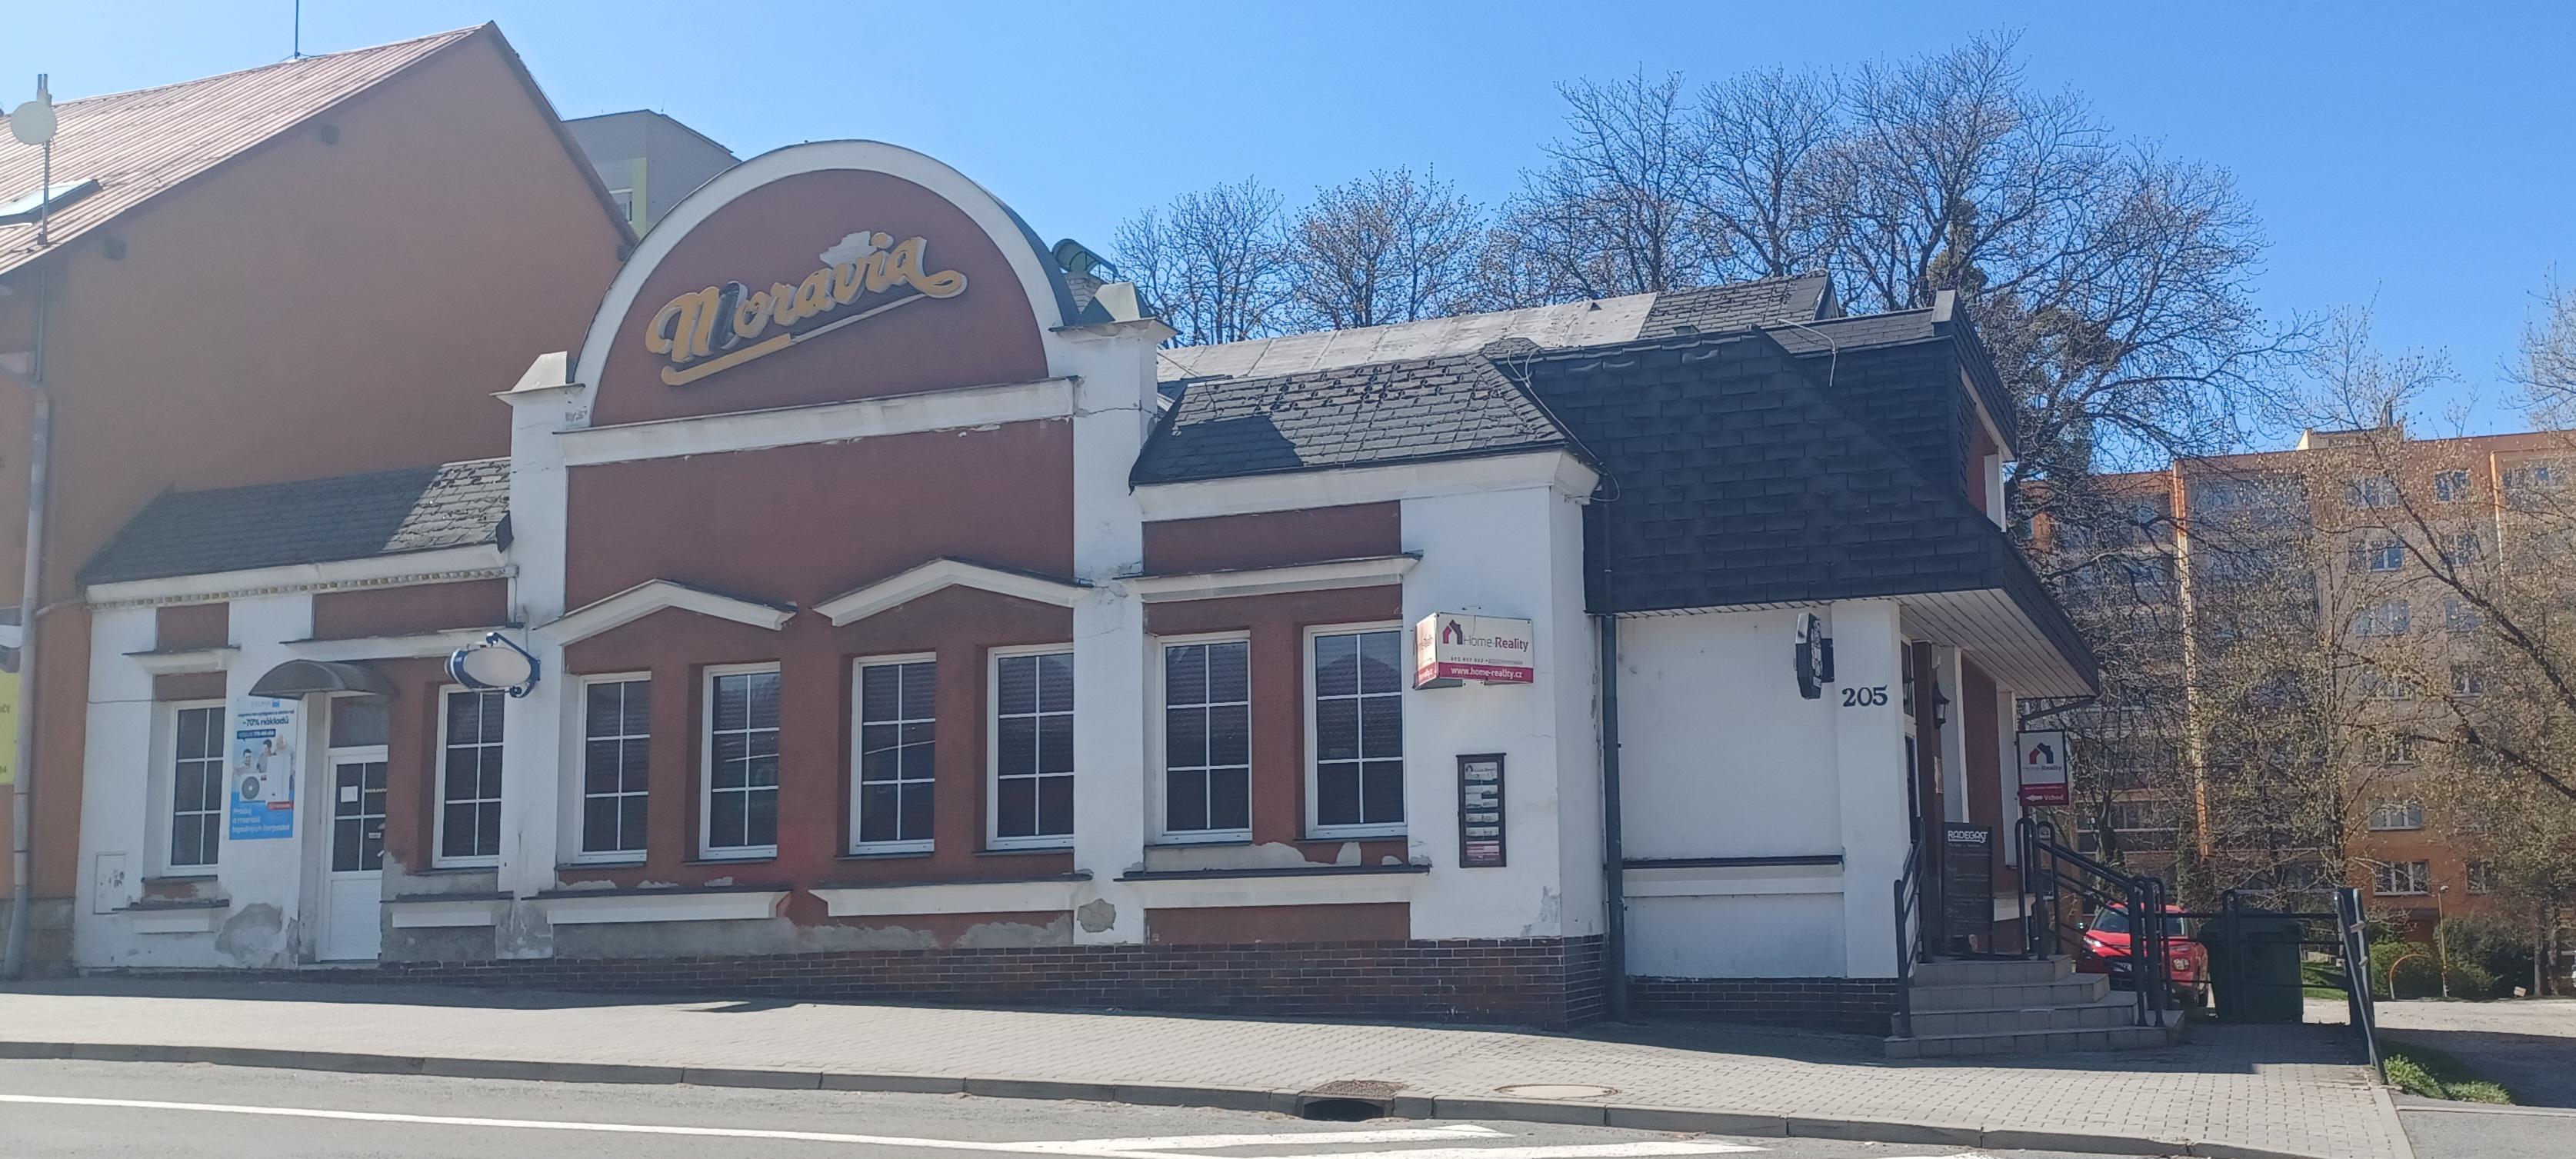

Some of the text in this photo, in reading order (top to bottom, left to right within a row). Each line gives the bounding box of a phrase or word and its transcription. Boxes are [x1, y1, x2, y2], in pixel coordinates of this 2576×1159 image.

[645, 231, 968, 363] Moravia
[1464, 634, 1528, 652] Home-Reality
[1451, 667, 1522, 679] www.home-reality.cz
[1841, 684, 1888, 707] 205
[1948, 830, 1988, 844] RADEGAST
